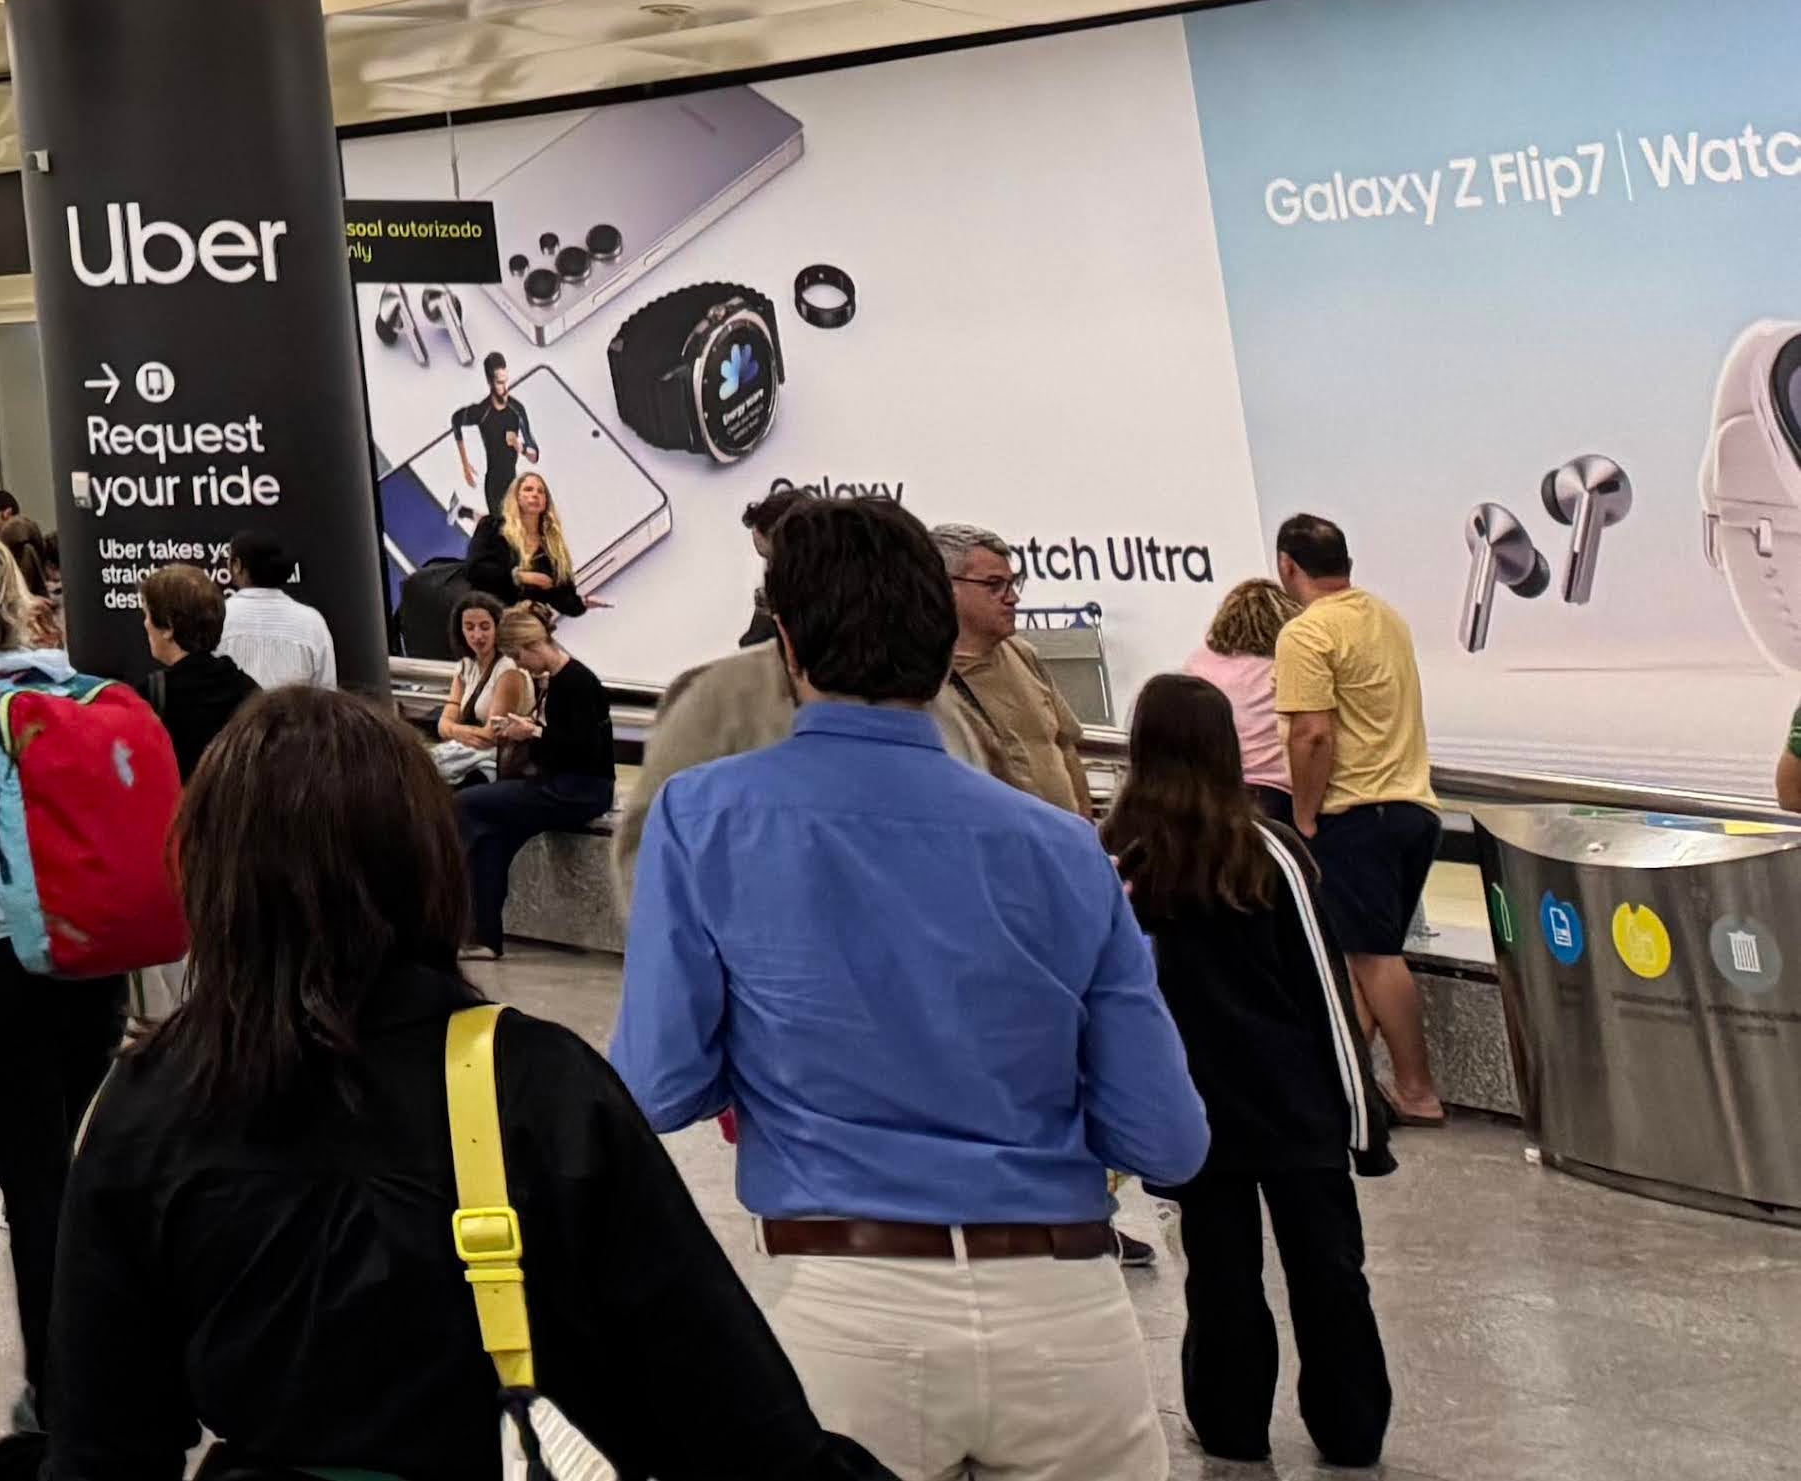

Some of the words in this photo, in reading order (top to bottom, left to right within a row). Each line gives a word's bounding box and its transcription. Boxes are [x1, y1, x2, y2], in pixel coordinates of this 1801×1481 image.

[1265, 169, 1442, 225] Galaxy
[1448, 158, 1481, 209] Z
[1490, 142, 1605, 216] Flip7
[1638, 123, 1801, 187] Watc
[67, 202, 286, 286] Uber
[346, 220, 383, 237] soal
[387, 220, 482, 238] autorizado
[348, 242, 373, 263] nly
[88, 414, 265, 463] Request
[91, 474, 179, 516] your
[192, 466, 281, 506] ride
[98, 539, 144, 560] Uber
[148, 539, 205, 560] takes
[1009, 536, 1099, 581] atch
[1106, 536, 1213, 583] Ultra
